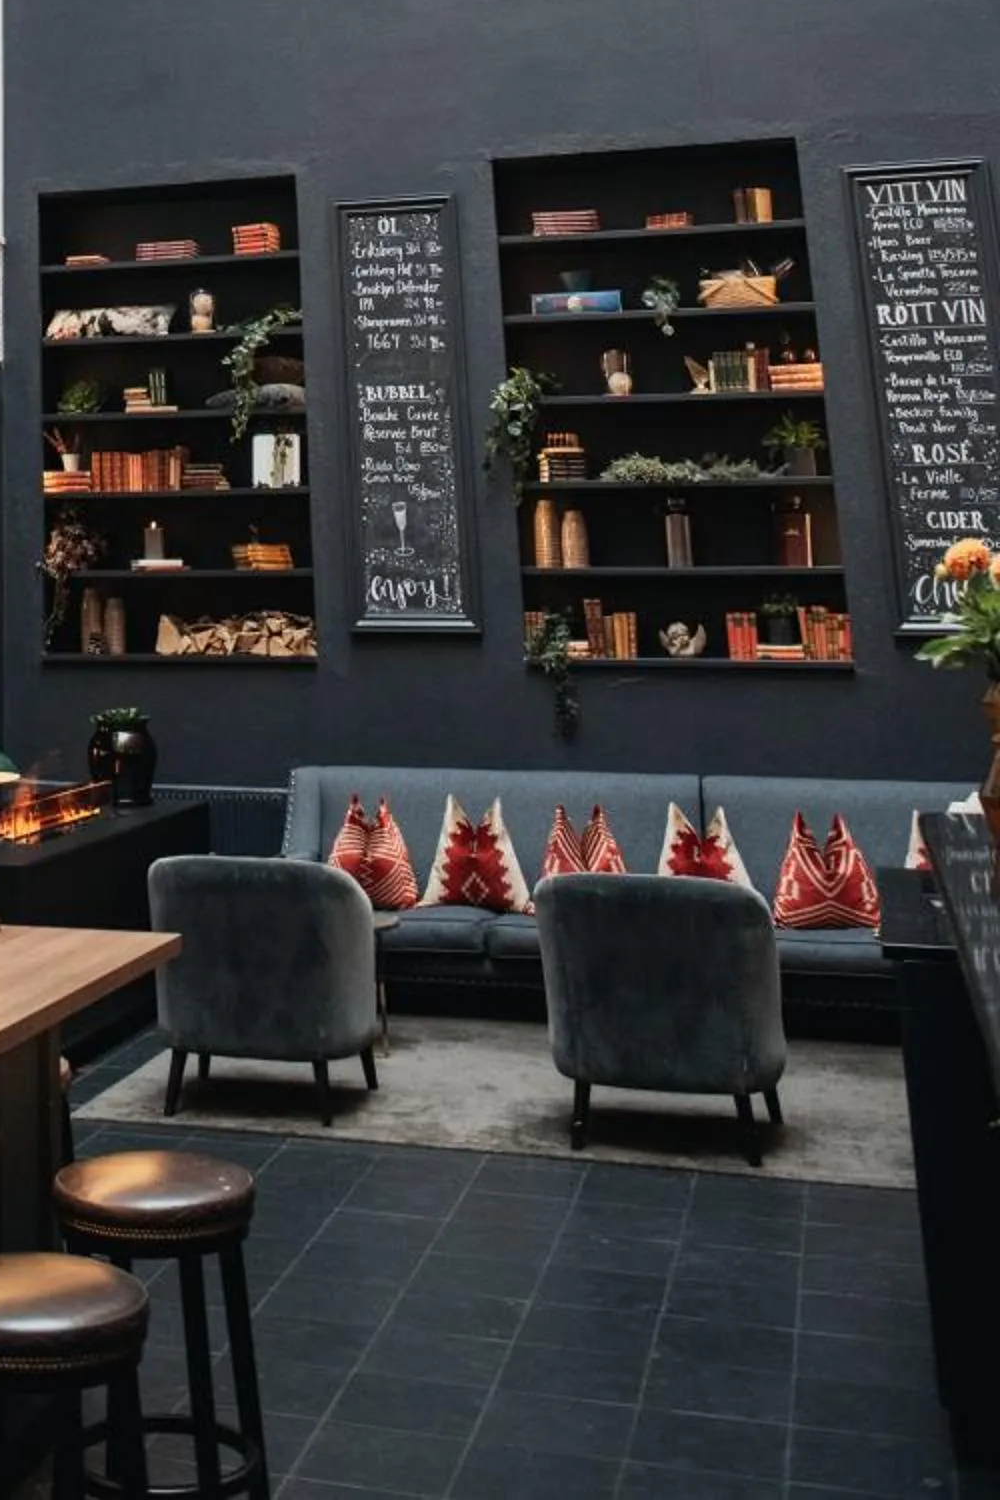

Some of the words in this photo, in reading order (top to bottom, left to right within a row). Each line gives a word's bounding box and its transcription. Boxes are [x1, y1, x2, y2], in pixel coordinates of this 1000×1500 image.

[866, 181, 920, 204] VITT
[926, 179, 967, 202] VIN
[355, 241, 403, 262] Eriksberg
[355, 264, 396, 281] Carlsberg
[878, 267, 895, 282] La
[360, 298, 375, 311] IPA
[876, 301, 937, 326] RÖTT
[941, 299, 986, 326] VIN
[367, 333, 400, 349] 1664
[365, 385, 431, 401] BUBBEL
[411, 425, 439, 439] Brut
[912, 439, 975, 464] ROSÉ
[901, 471, 919, 485] La
[926, 510, 989, 532] CIDER
